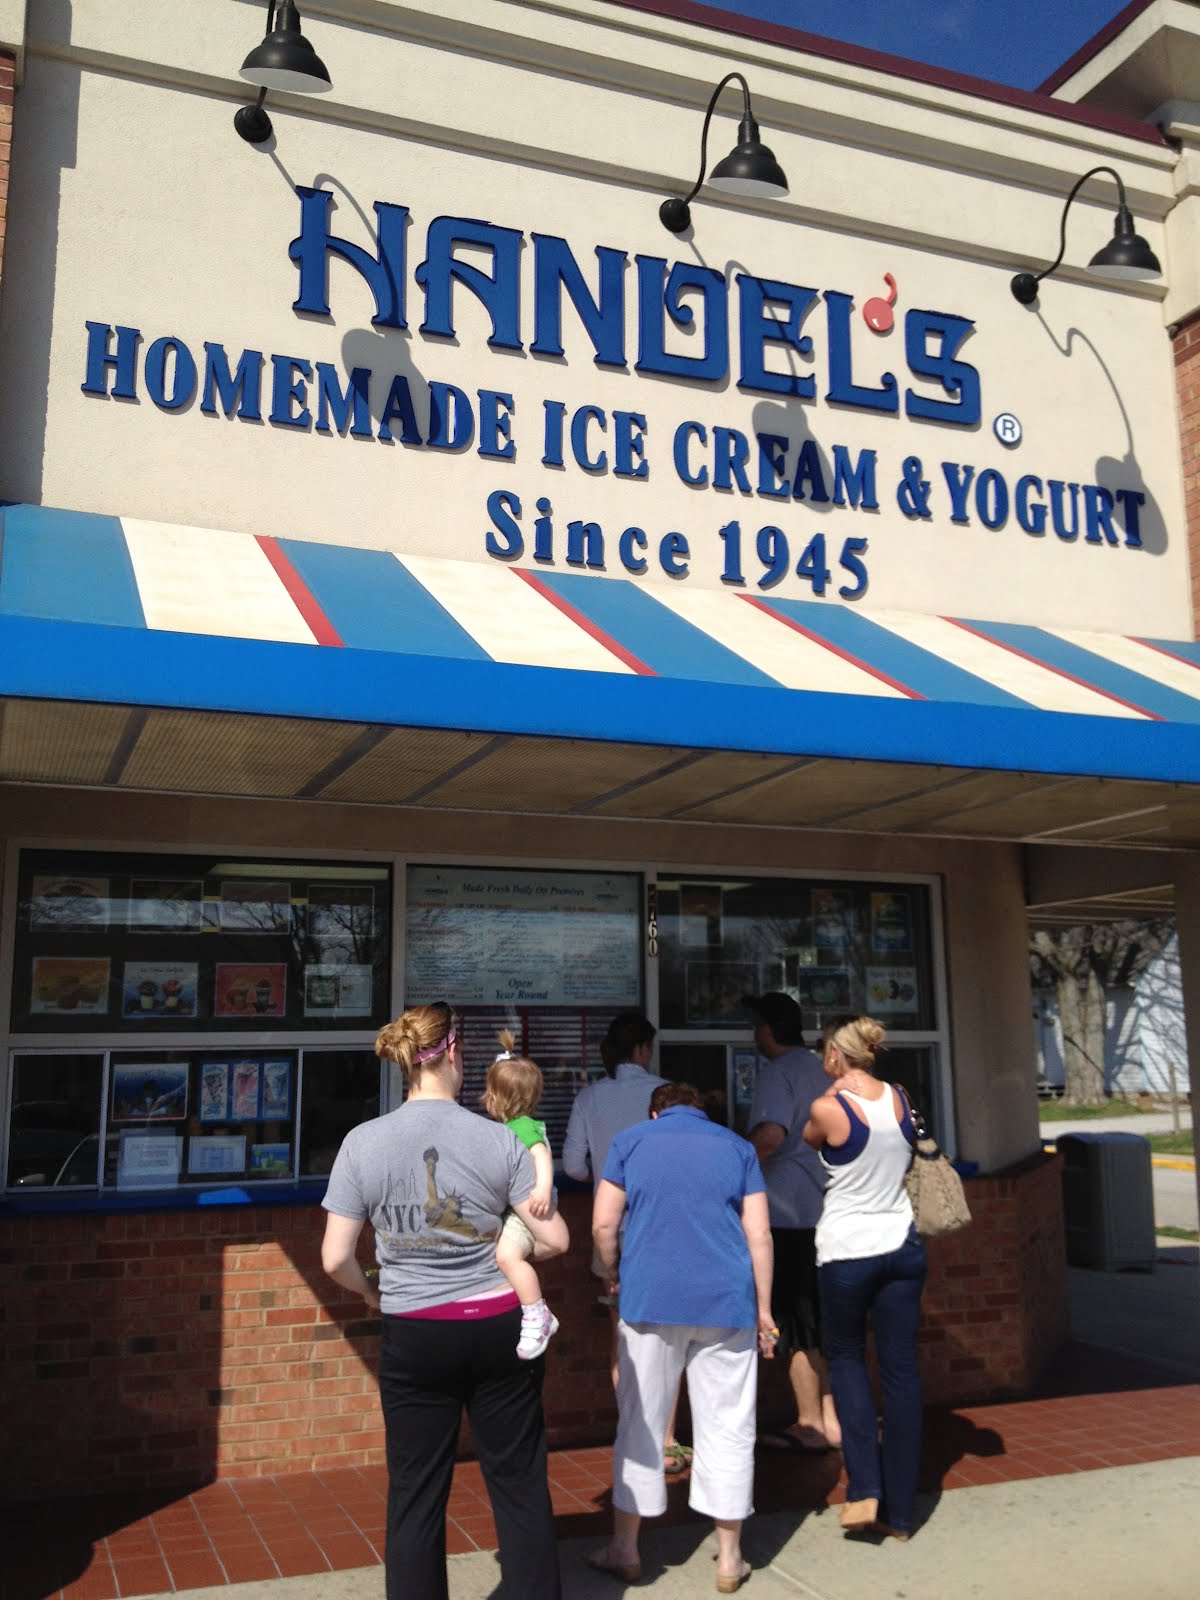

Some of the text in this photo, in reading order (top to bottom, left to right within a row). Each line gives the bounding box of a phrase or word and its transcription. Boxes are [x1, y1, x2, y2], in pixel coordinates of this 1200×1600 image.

[81, 320, 1146, 548] HOMEMADE ICE CREAM & YOGURT
[485, 490, 869, 598] Since 1945
[463, 882, 484, 893] Made
[487, 884, 510, 894] Fresh
[512, 884, 534, 897] Daily
[496, 989, 515, 1000] Year
[518, 990, 548, 1000] Round
[508, 978, 533, 990] Open
[381, 1204, 421, 1233] NYC
